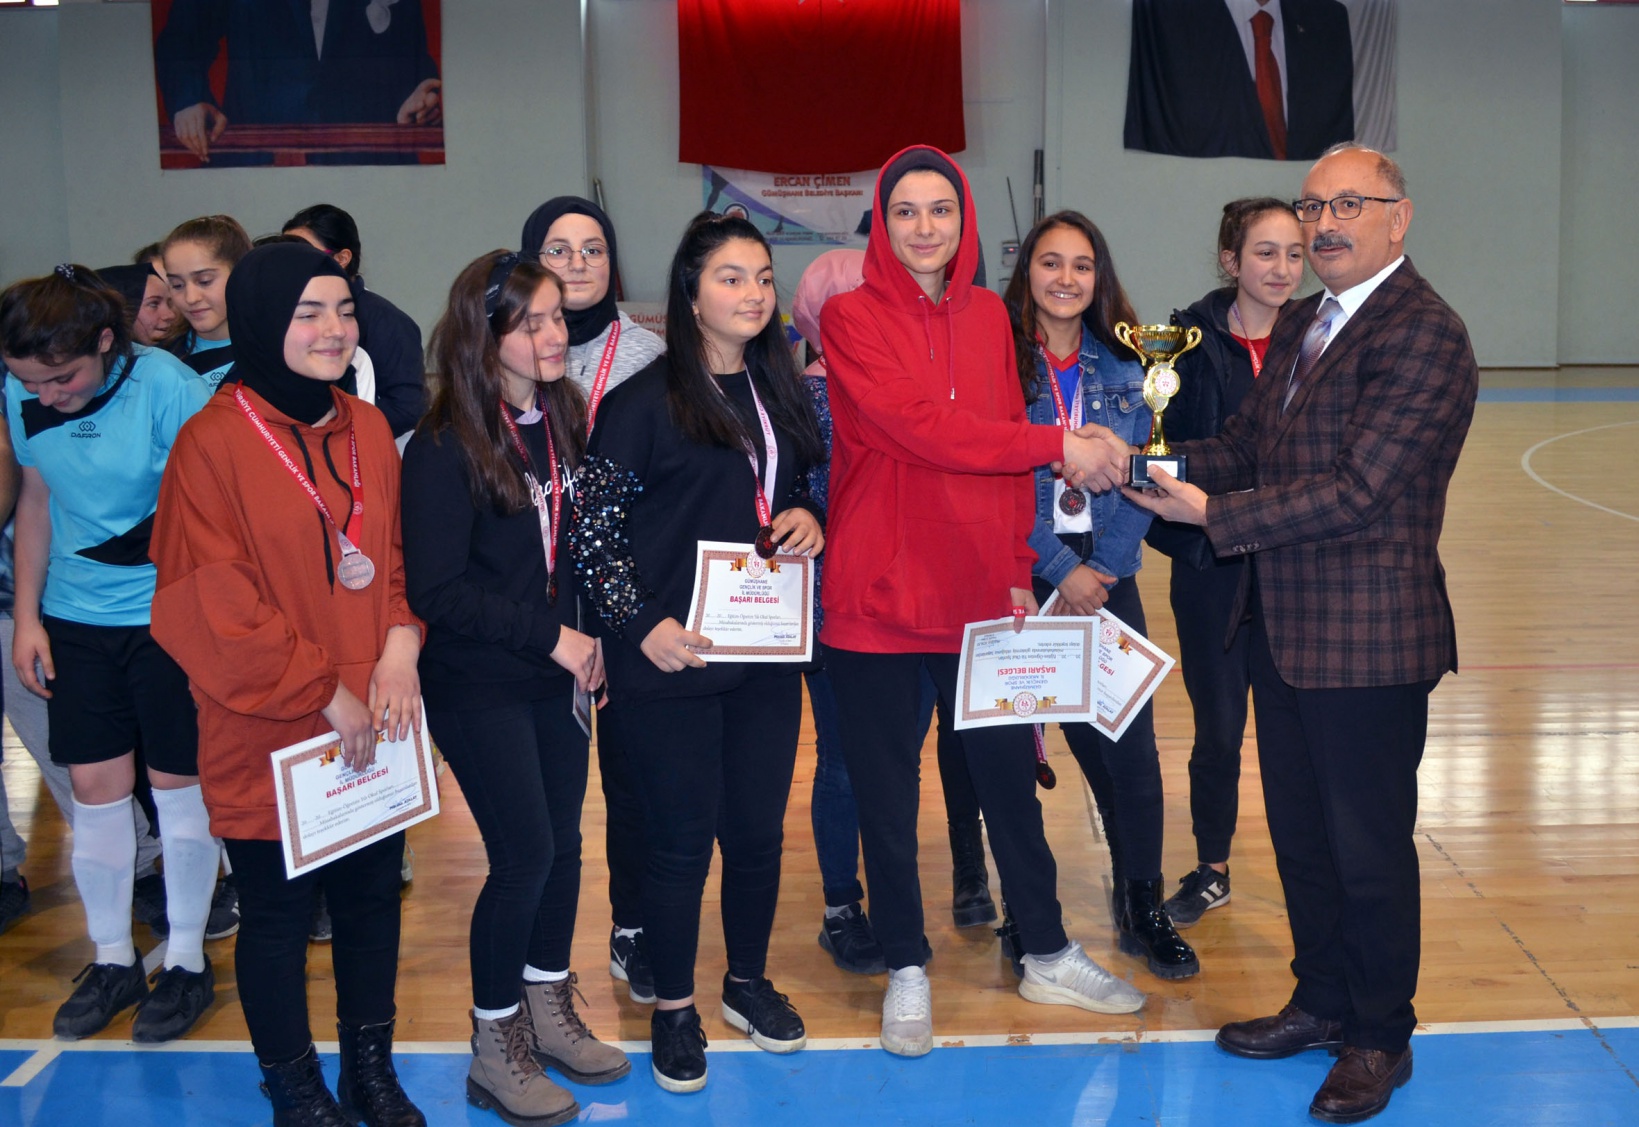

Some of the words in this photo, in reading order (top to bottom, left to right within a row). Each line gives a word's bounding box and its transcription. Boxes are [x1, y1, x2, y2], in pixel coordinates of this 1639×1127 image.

[774, 176, 810, 186] ERCAN
[814, 174, 850, 188] ÇİMEN
[596, 369, 606, 390] GENÇLİK
[235, 389, 252, 412] TÜRKİYE
[249, 411, 281, 452] CUMHURİYETİ
[278, 449, 299, 475] GENÇLİK
[297, 473, 305, 482] VE
[302, 480, 316, 497] SPOR
[730, 596, 753, 604] BAŞARI
[998, 668, 1026, 677] BELGESİ
[1028, 665, 1056, 673] BAŞARI
[326, 781, 355, 798] BAŞARI
[357, 766, 388, 786] BELGESİ
